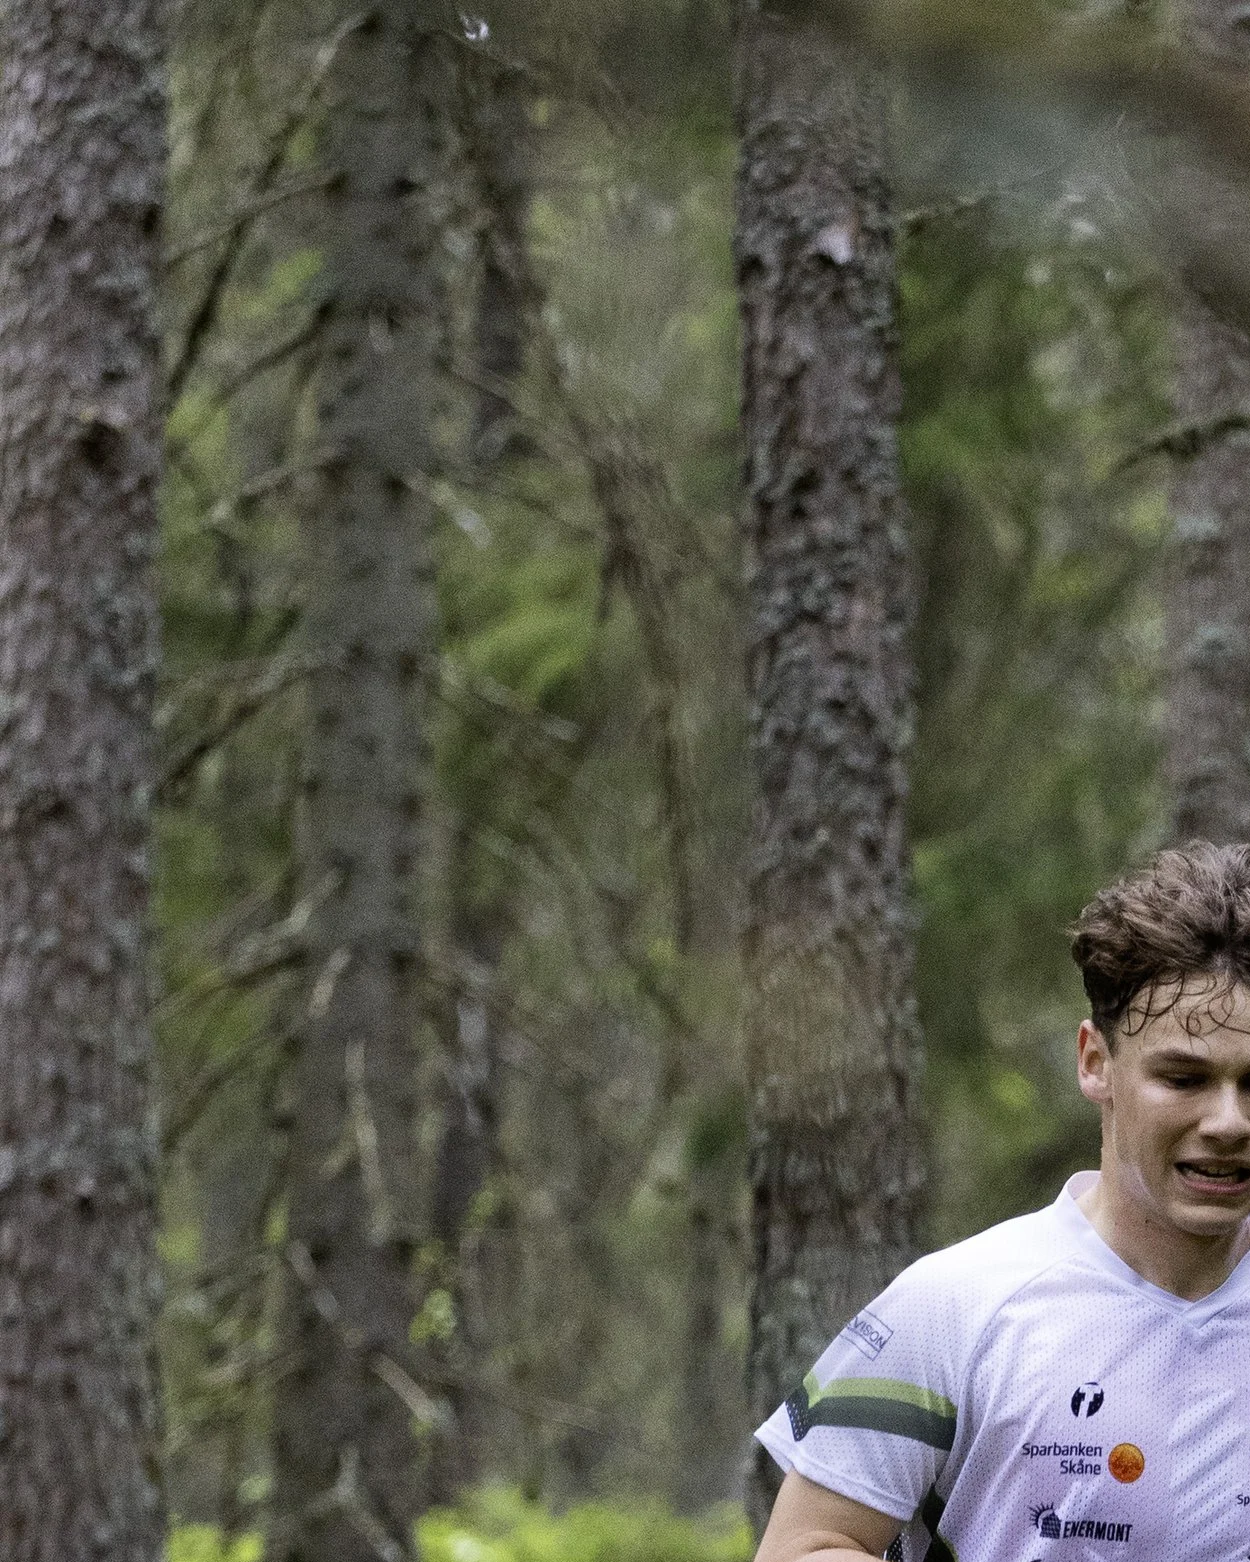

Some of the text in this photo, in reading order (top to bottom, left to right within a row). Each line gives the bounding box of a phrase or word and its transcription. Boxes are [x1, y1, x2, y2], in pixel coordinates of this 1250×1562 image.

[852, 1316, 887, 1348] VISON
[1022, 1442, 1102, 1458] Sparbanken
[1060, 1459, 1101, 1475] Skåne
[1063, 1521, 1133, 1542] ENERMONT
